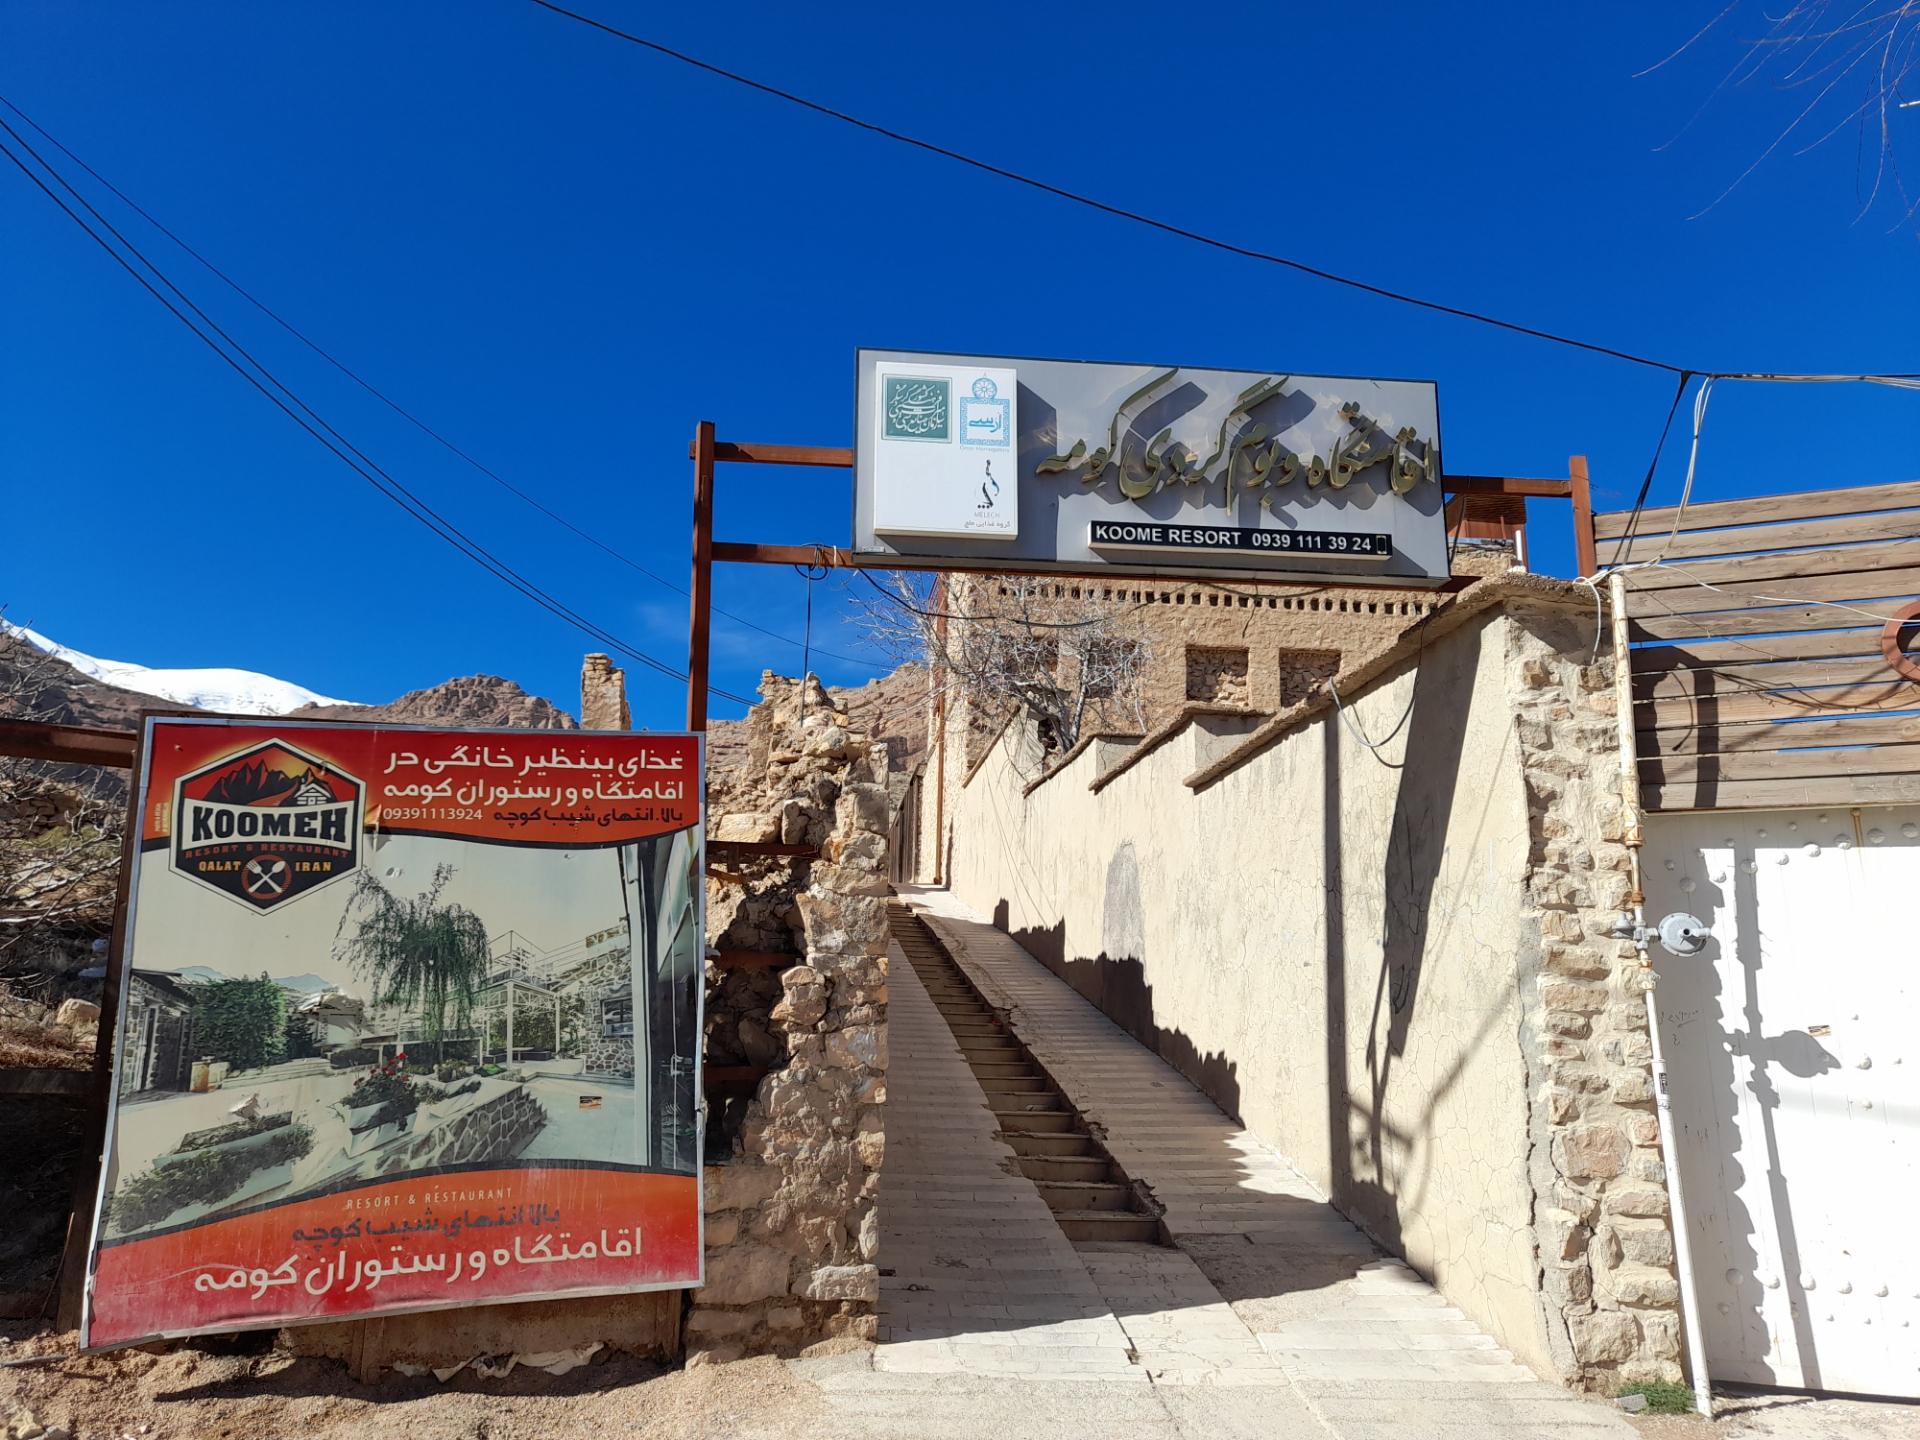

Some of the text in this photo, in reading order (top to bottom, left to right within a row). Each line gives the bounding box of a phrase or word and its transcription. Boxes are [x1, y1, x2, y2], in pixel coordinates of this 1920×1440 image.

[1096, 525, 1372, 551] KOOME RESORT 0939 111 39 24
[383, 745, 684, 778] غذای بینظیر خانگی در
[383, 778, 684, 807] اقامتگاه و رستوران کومه
[192, 806, 348, 843] KOOMEH
[383, 808, 484, 820] 09391113924
[493, 808, 541, 828] کوچه
[544, 805, 595, 828] شیب
[184, 844, 239, 859] RESORT
[261, 843, 349, 858] RESTAURANT
[199, 860, 332, 872] QALAT IRAN
[346, 1195, 400, 1210] RESORT
[408, 1194, 416, 1205] &
[292, 1216, 362, 1251] کوچه
[194, 1227, 642, 1300] اقامتگاه و رستوران کومه
